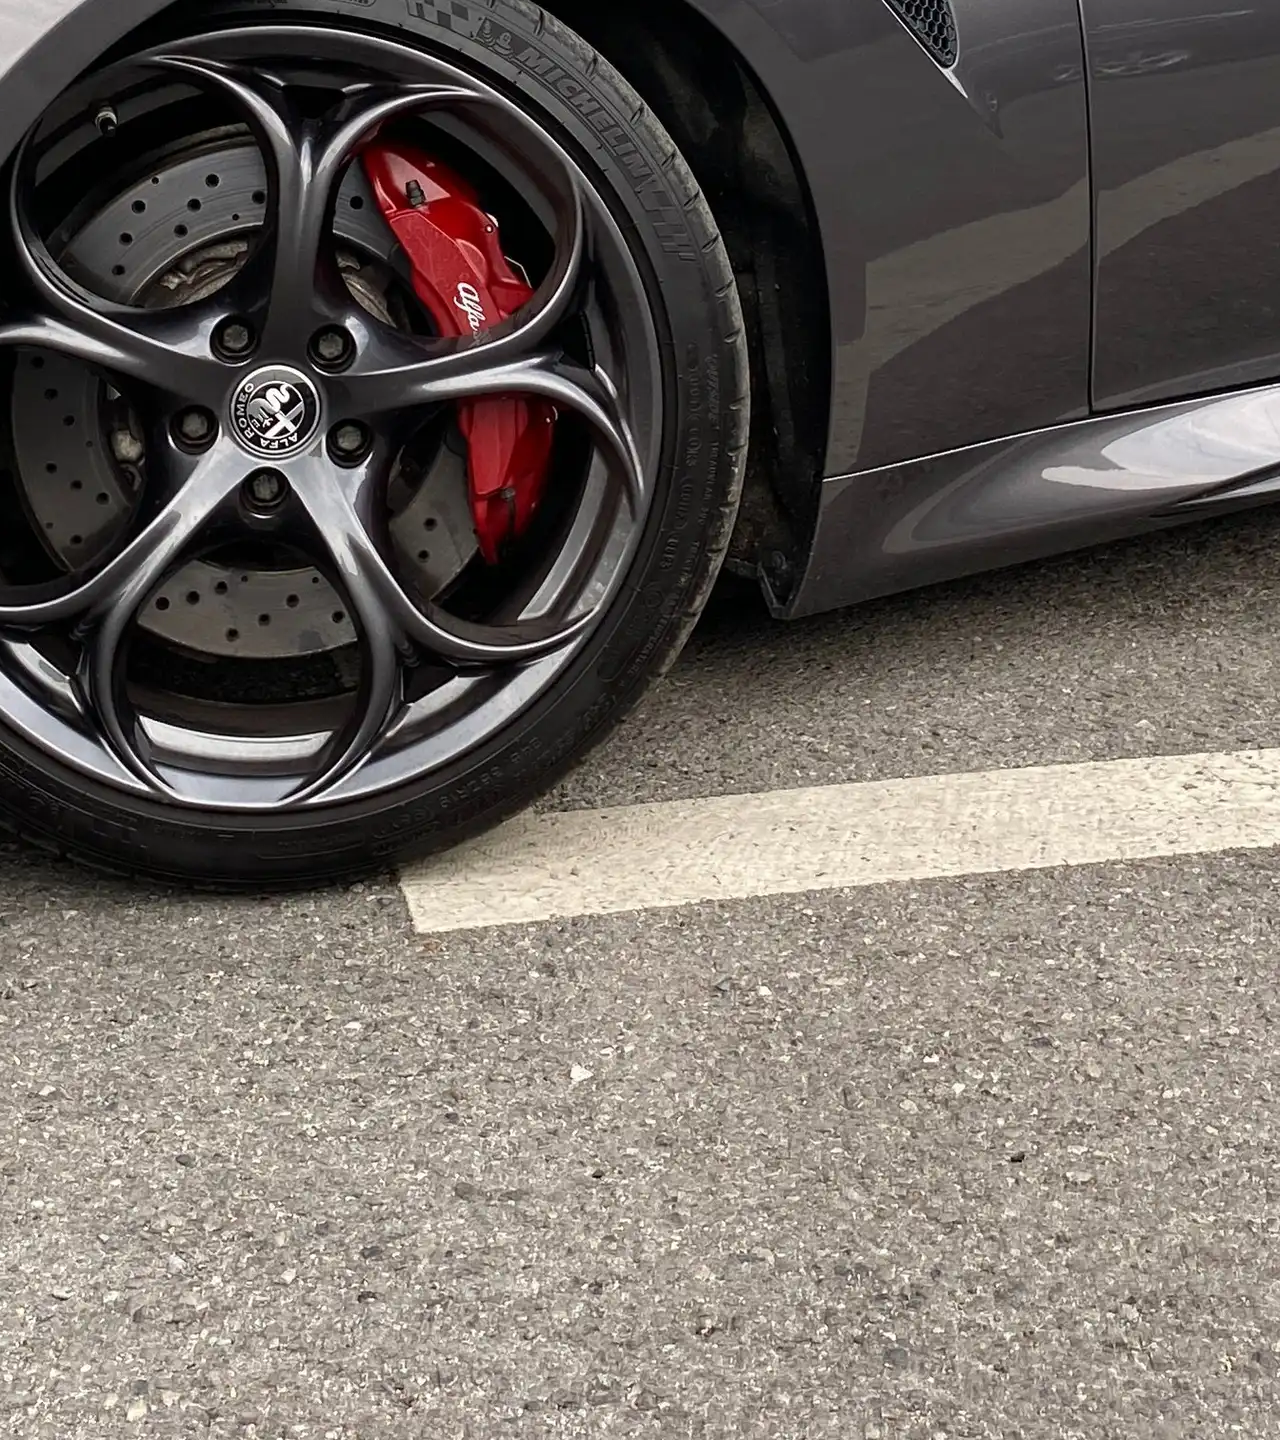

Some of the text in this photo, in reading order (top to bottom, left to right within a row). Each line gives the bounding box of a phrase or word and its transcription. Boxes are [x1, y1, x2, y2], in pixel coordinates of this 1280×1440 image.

[517, 47, 654, 179] MICHELIN
[236, 383, 298, 449] ALFA ROMEO
